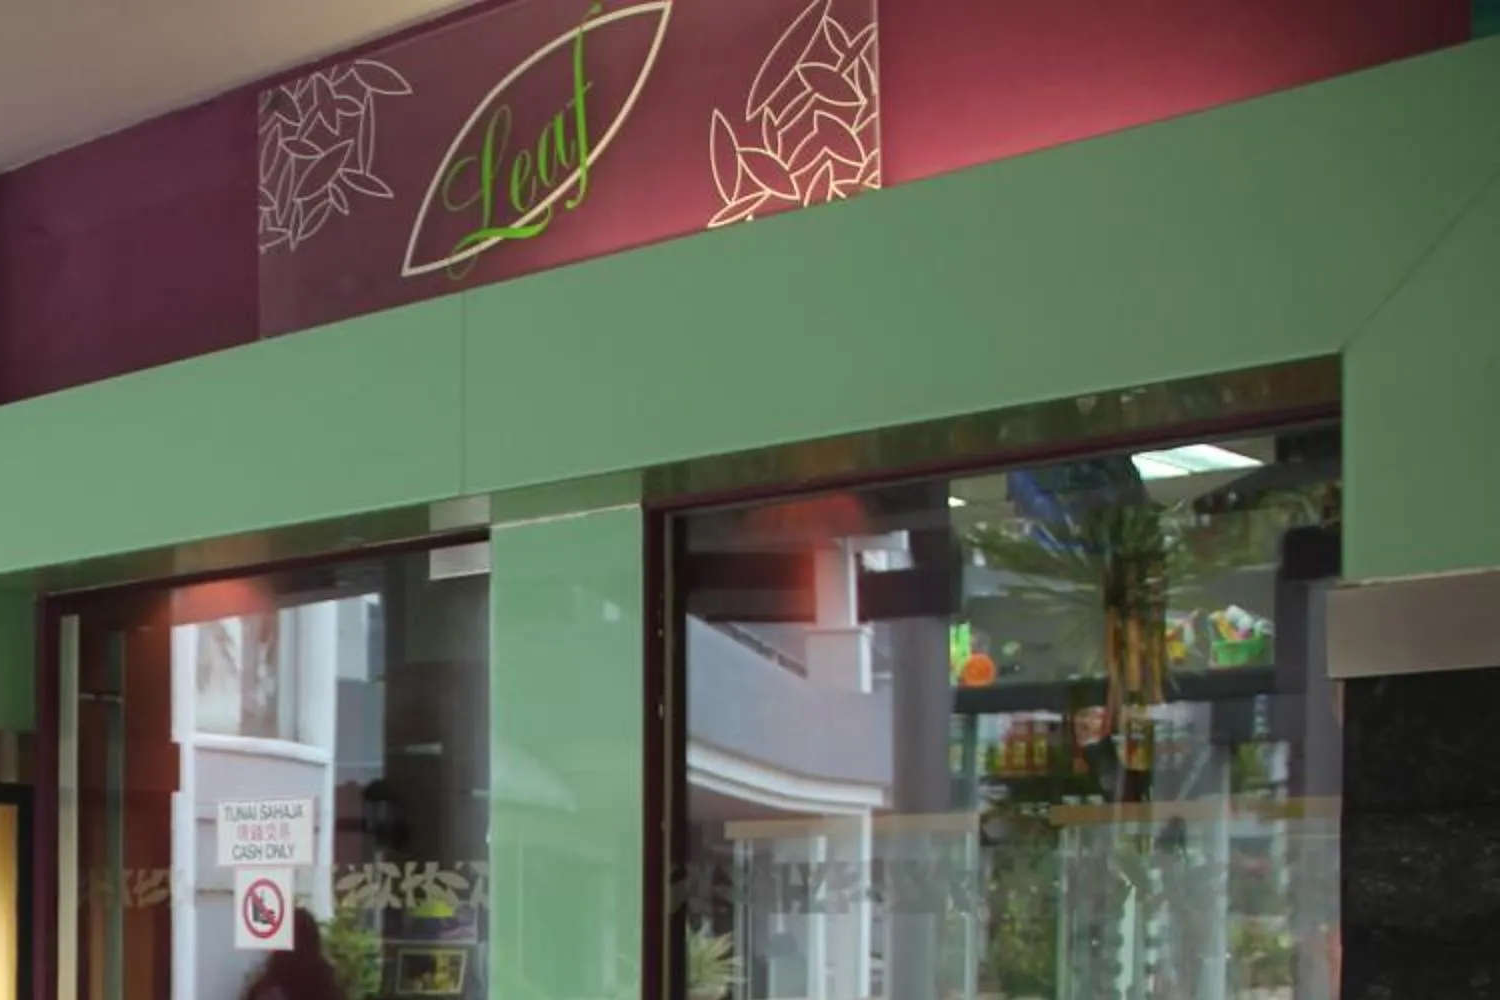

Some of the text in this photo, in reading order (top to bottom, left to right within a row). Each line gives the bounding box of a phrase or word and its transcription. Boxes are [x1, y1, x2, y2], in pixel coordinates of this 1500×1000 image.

[443, 3, 602, 280] Leaf
[225, 803, 304, 822] TUNAI SAHAJA
[232, 843, 294, 860] CASH ONLY
